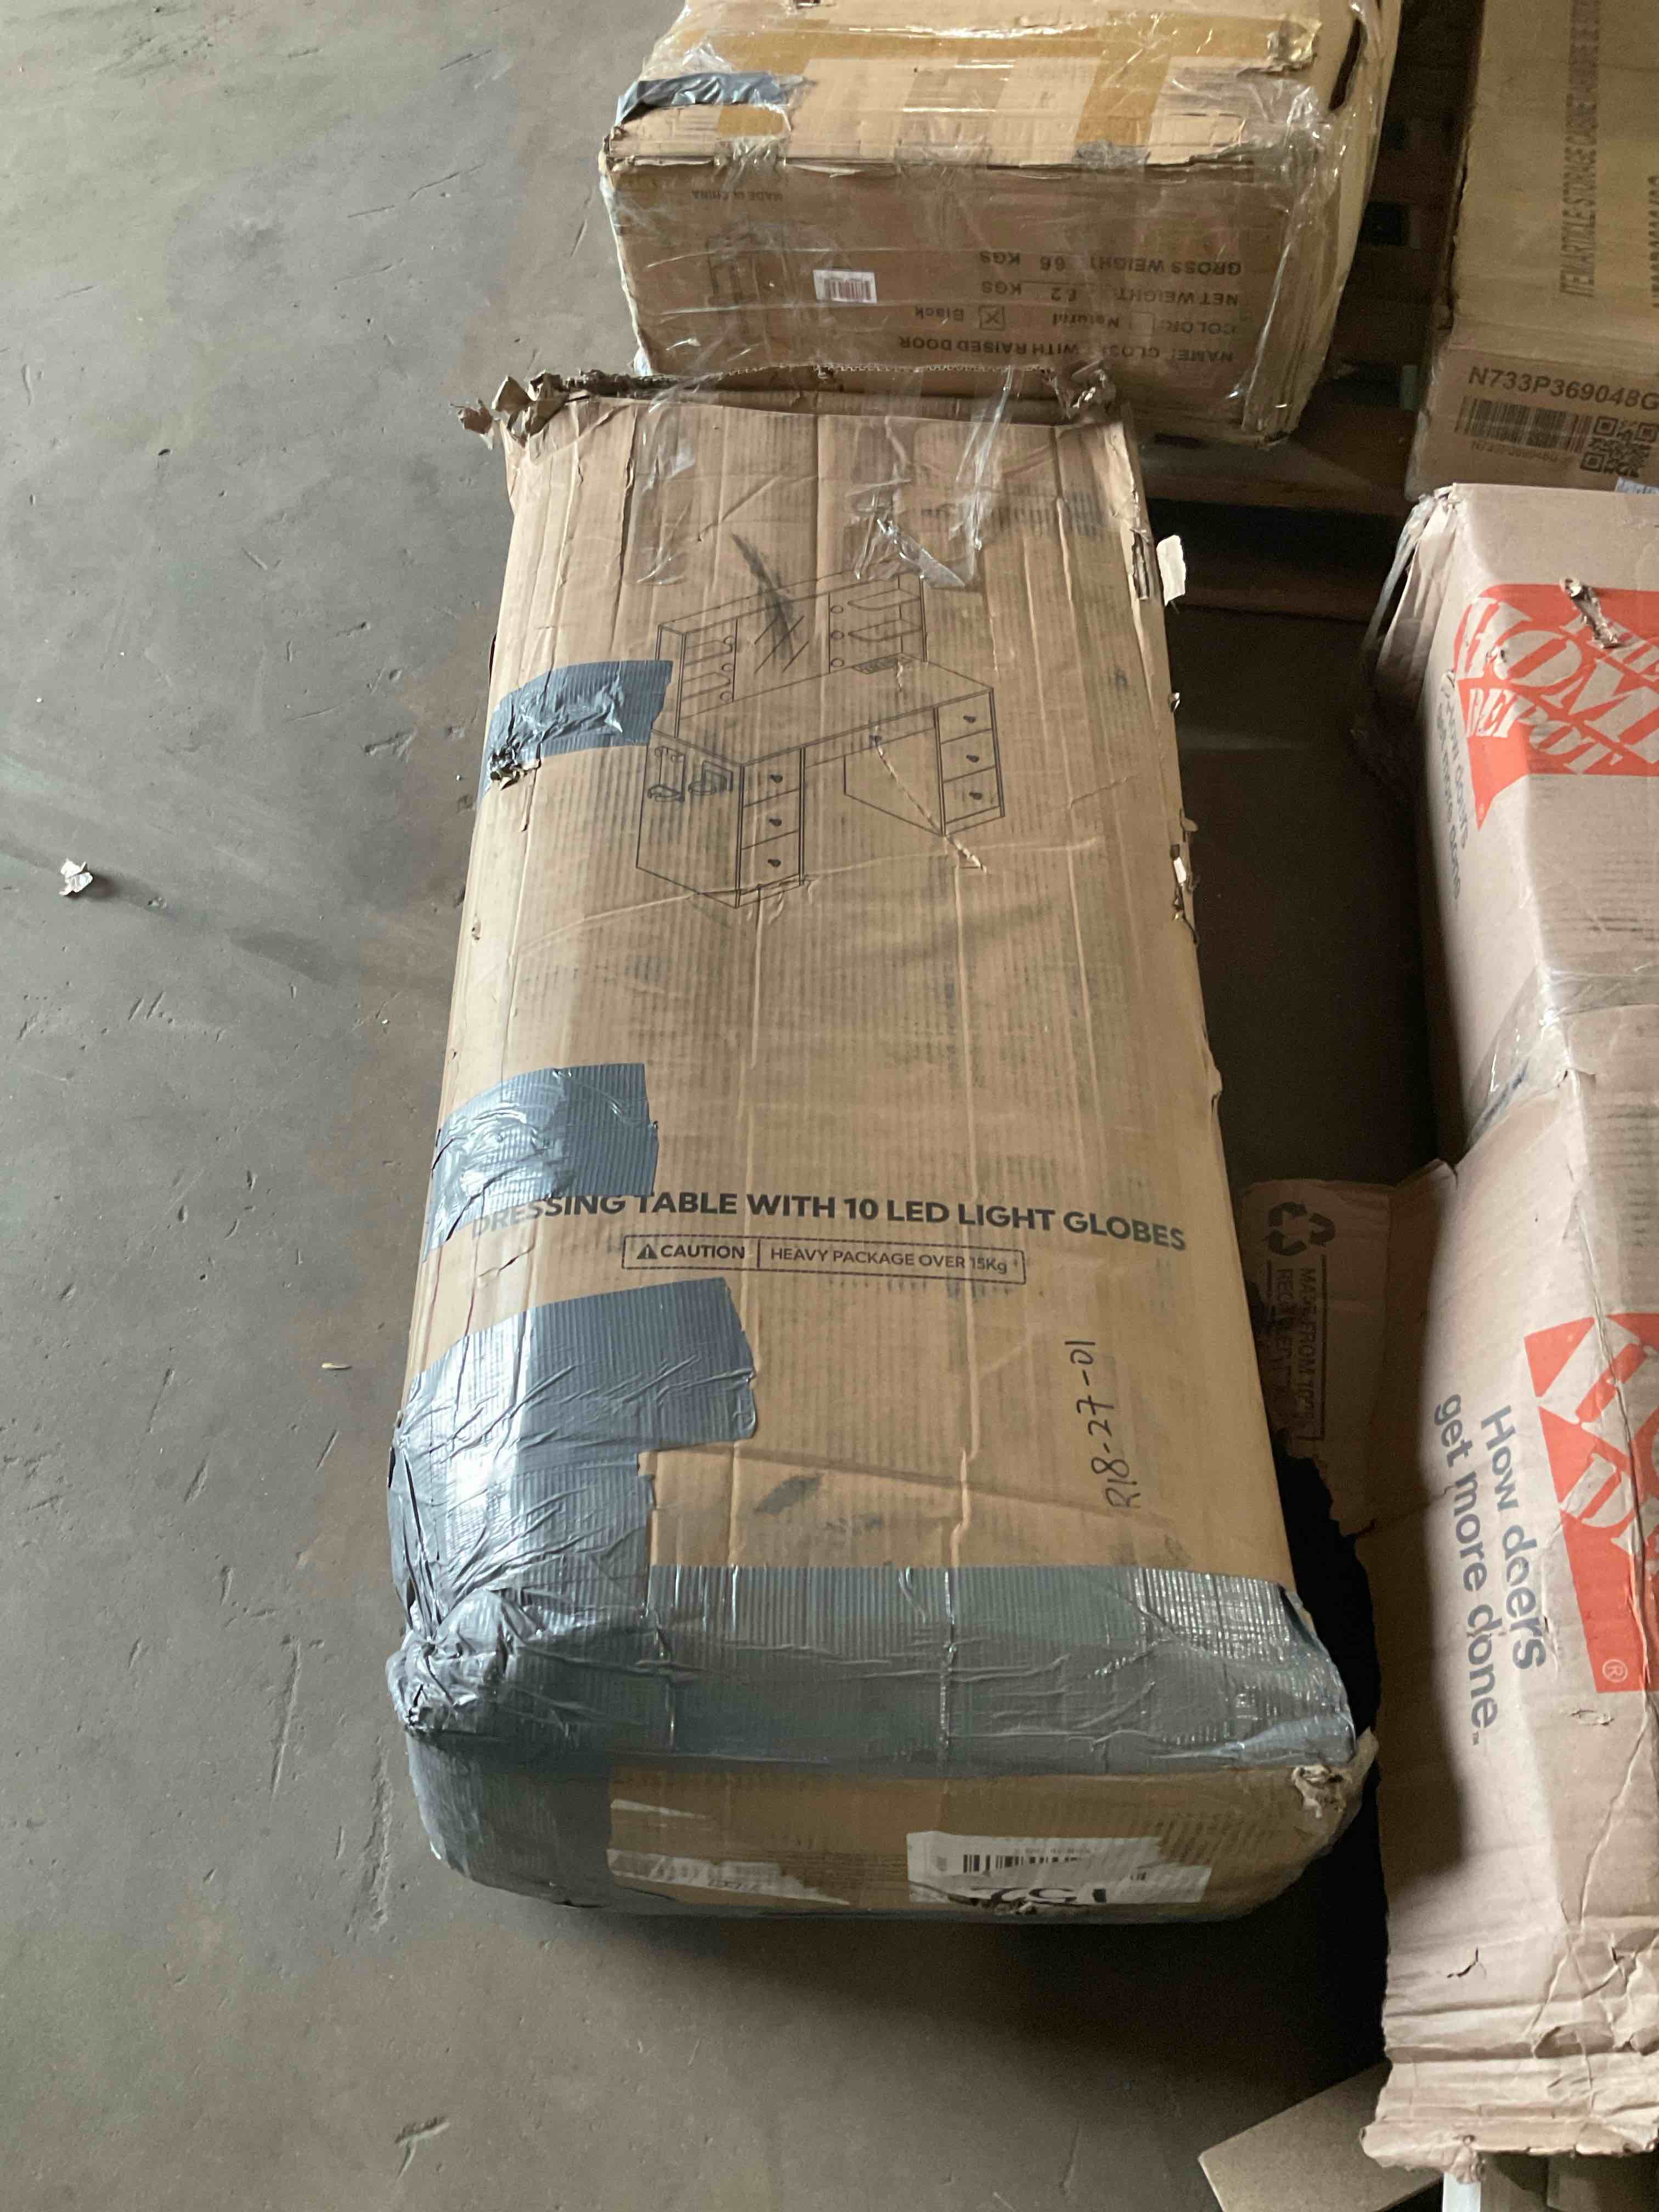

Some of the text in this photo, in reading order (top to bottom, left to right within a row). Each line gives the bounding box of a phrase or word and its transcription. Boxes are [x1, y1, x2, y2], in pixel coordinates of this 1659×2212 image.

[979, 250, 1021, 266] KGS
[1172, 261, 1242, 276] GROSS
[980, 280, 1022, 296] KGS
[1203, 292, 1238, 307] NET
[899, 335, 952, 351] DOOR
[957, 337, 1027, 355] RAISED
[1028, 341, 1079, 356] WITH
[1468, 366, 1659, 410] N733P369048G
[638, 1192, 737, 1215] TABLE
[747, 1193, 836, 1219] WITH
[844, 1197, 878, 1221] 10
[887, 1199, 950, 1223] LED
[958, 1203, 1056, 1231] LIGHT
[1063, 1211, 1186, 1251] GLOBES
[661, 1245, 1007, 1275] CAUTION HEAVY PACKAGE OVER 15Kg
[1064, 1340, 1142, 1508] R18-27-01
[1434, 1393, 1473, 1469] get
[1453, 1470, 1488, 1593] more
[1480, 1404, 1547, 1671] How doers
[1467, 1604, 1503, 1729] done
